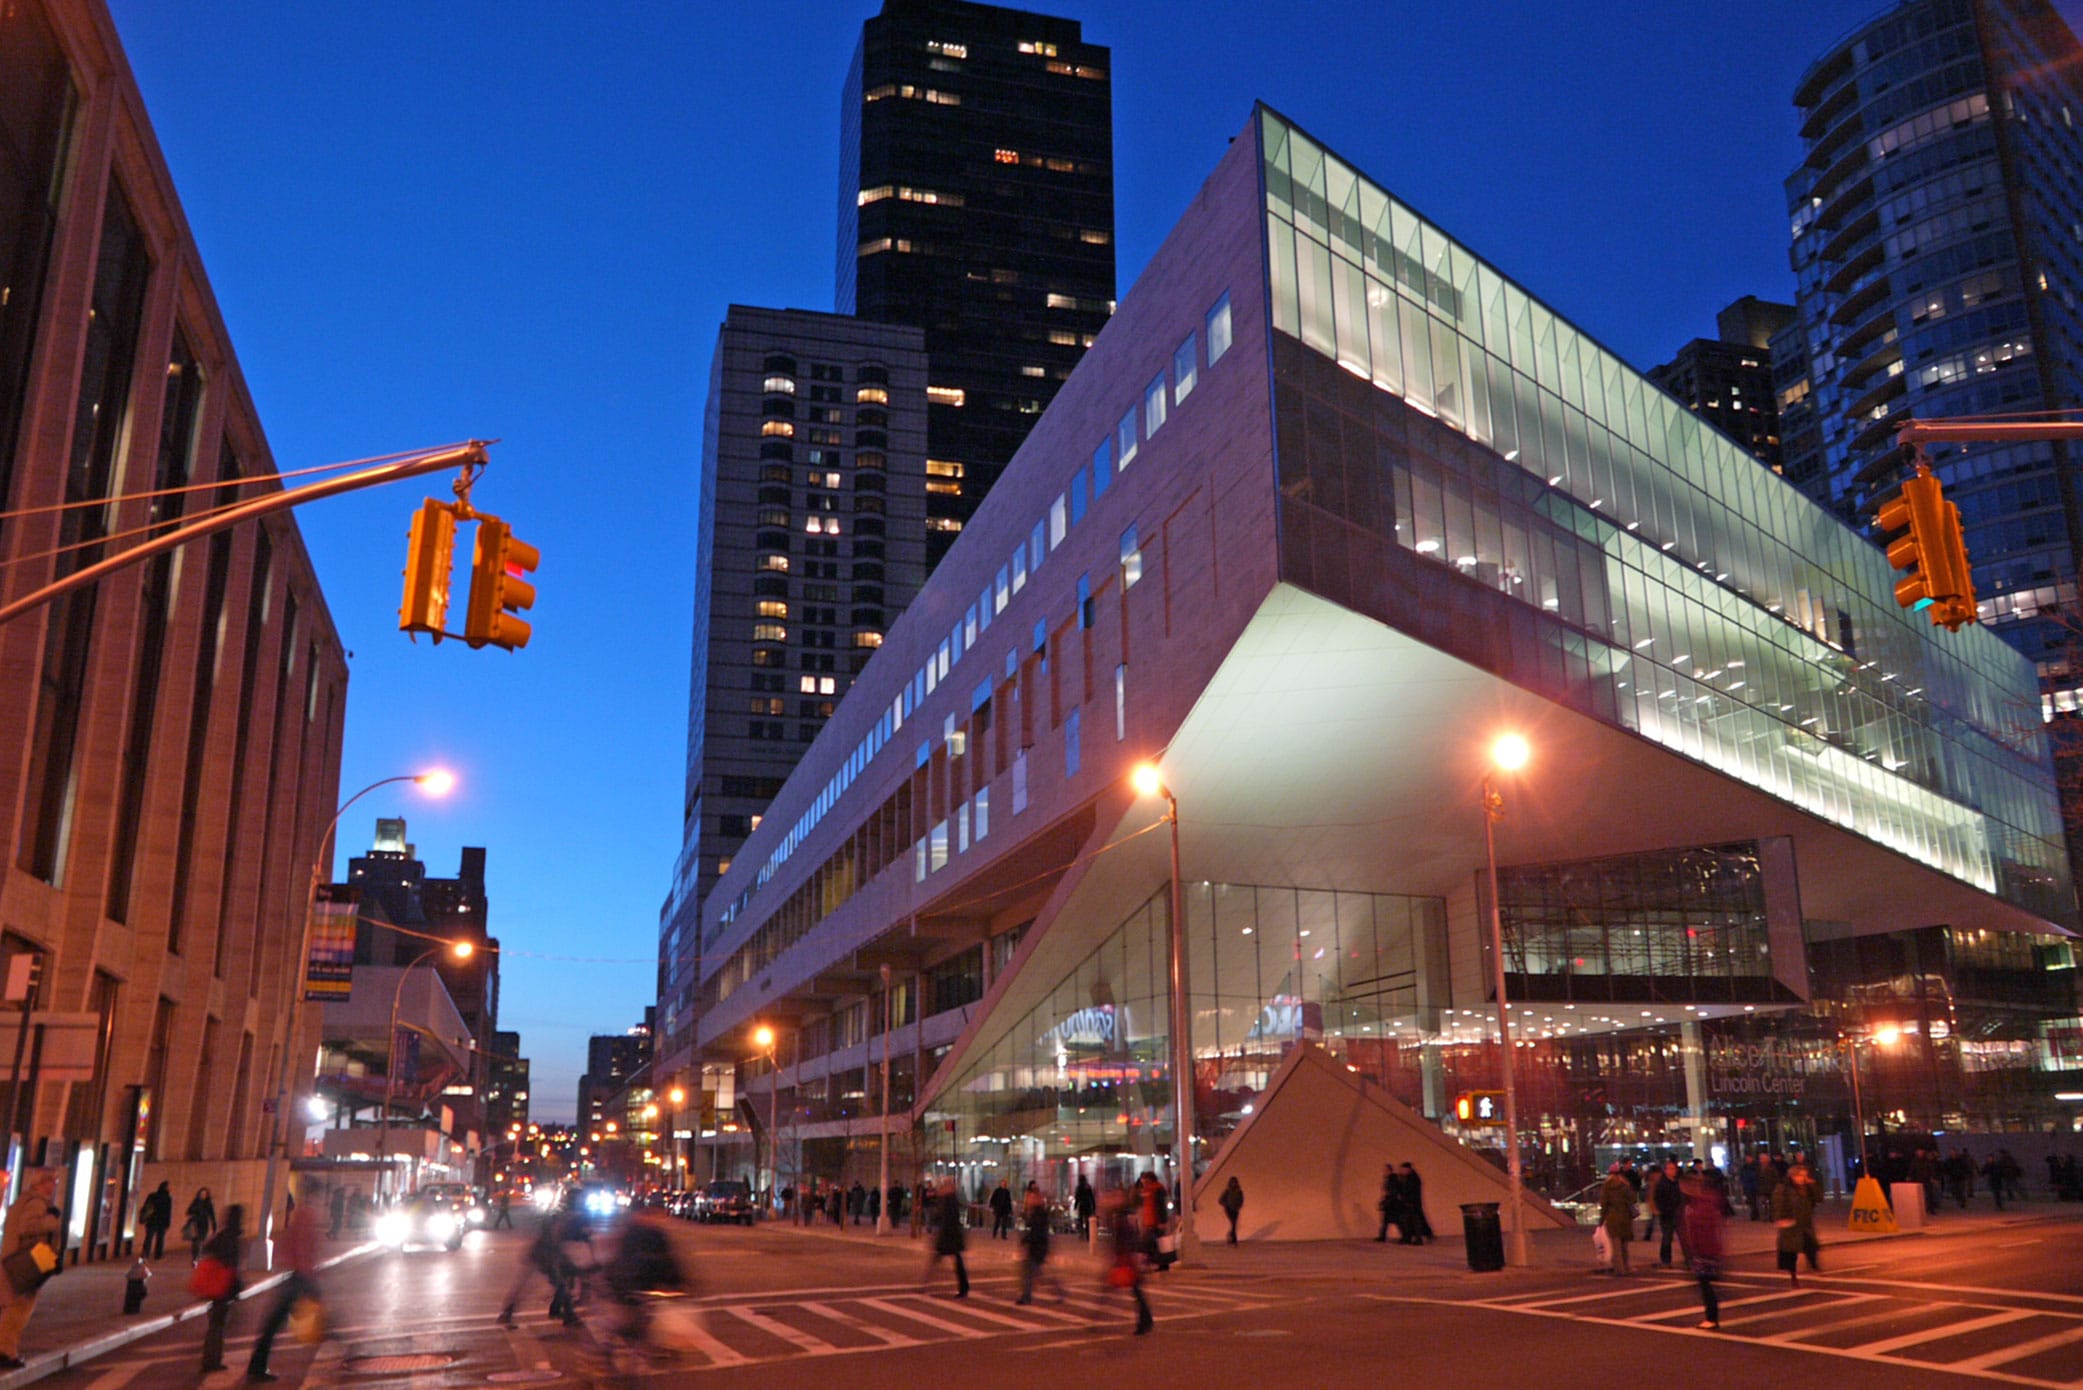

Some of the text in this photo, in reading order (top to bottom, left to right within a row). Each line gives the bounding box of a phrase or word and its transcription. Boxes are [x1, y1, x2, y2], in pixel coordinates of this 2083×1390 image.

[1709, 1034, 1761, 1068] Alice
[1711, 1071, 1806, 1094] Lincoln Center
